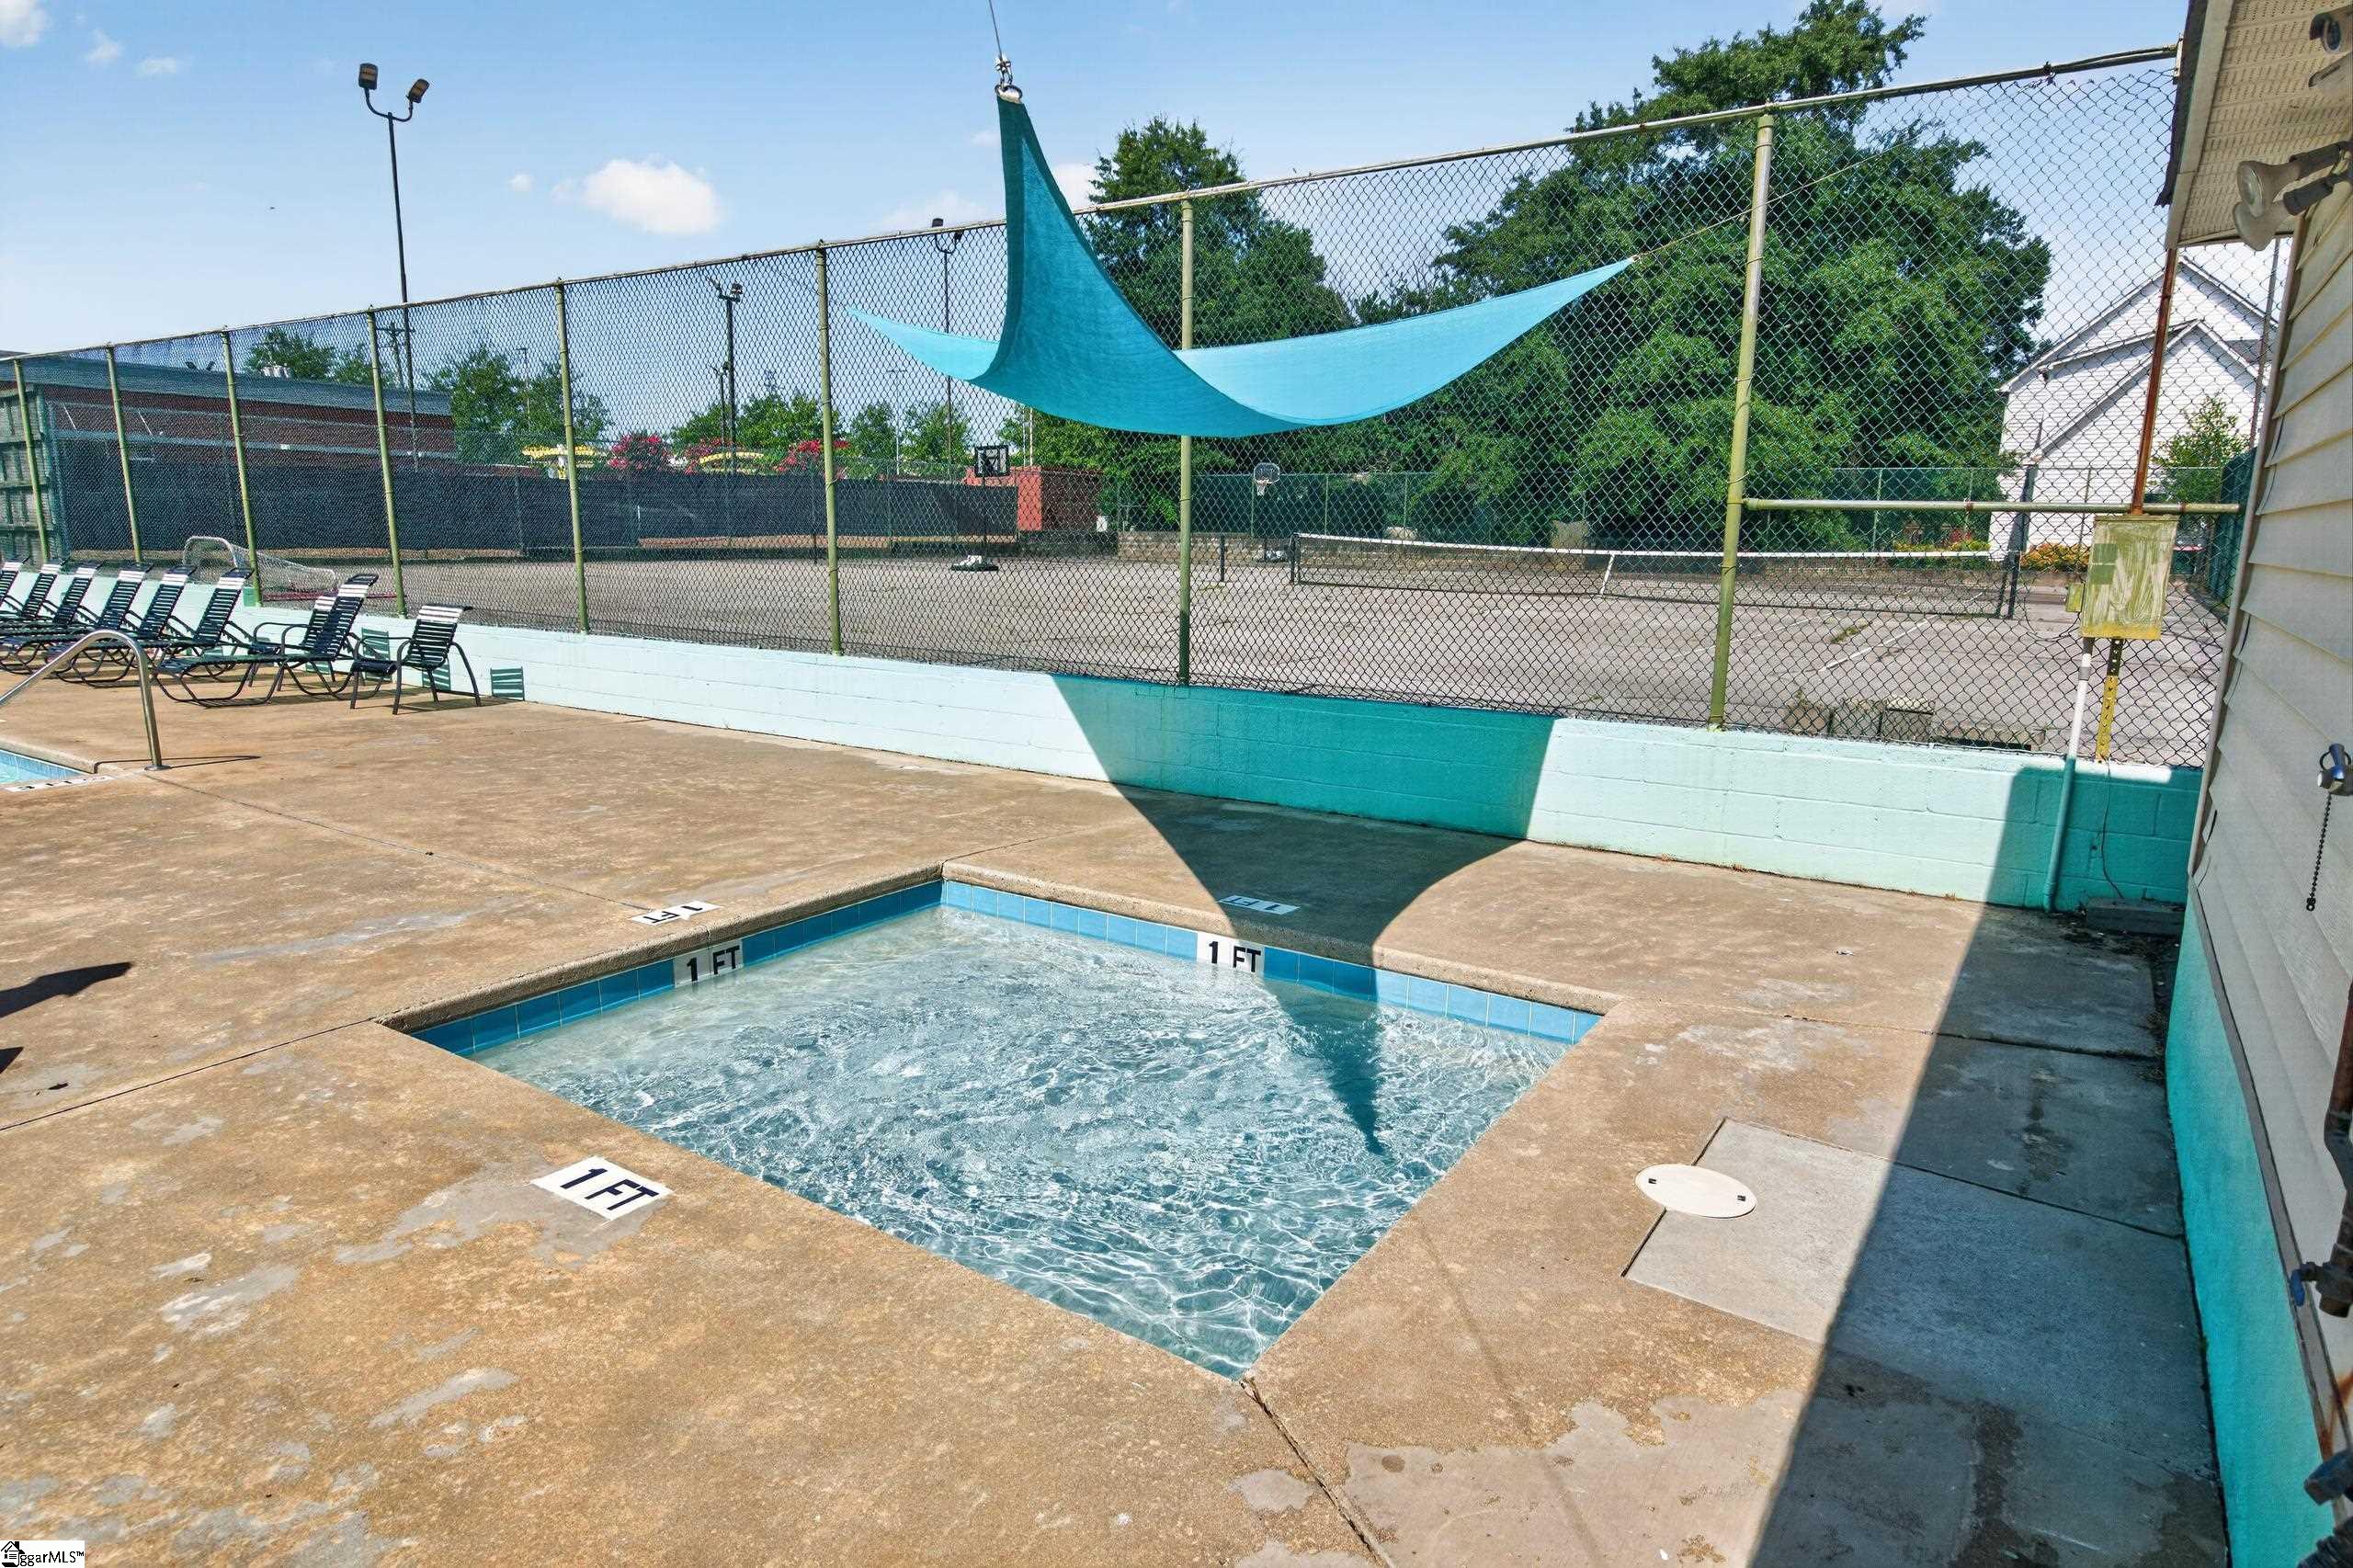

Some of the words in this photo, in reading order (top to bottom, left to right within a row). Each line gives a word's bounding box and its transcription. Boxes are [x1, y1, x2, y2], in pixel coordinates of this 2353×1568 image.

[687, 957, 699, 983] 1
[712, 945, 740, 975] FT
[1209, 940, 1219, 964] 1
[1233, 946, 1262, 973] FT
[560, 1167, 608, 1189] 1
[584, 1178, 660, 1211] FT
